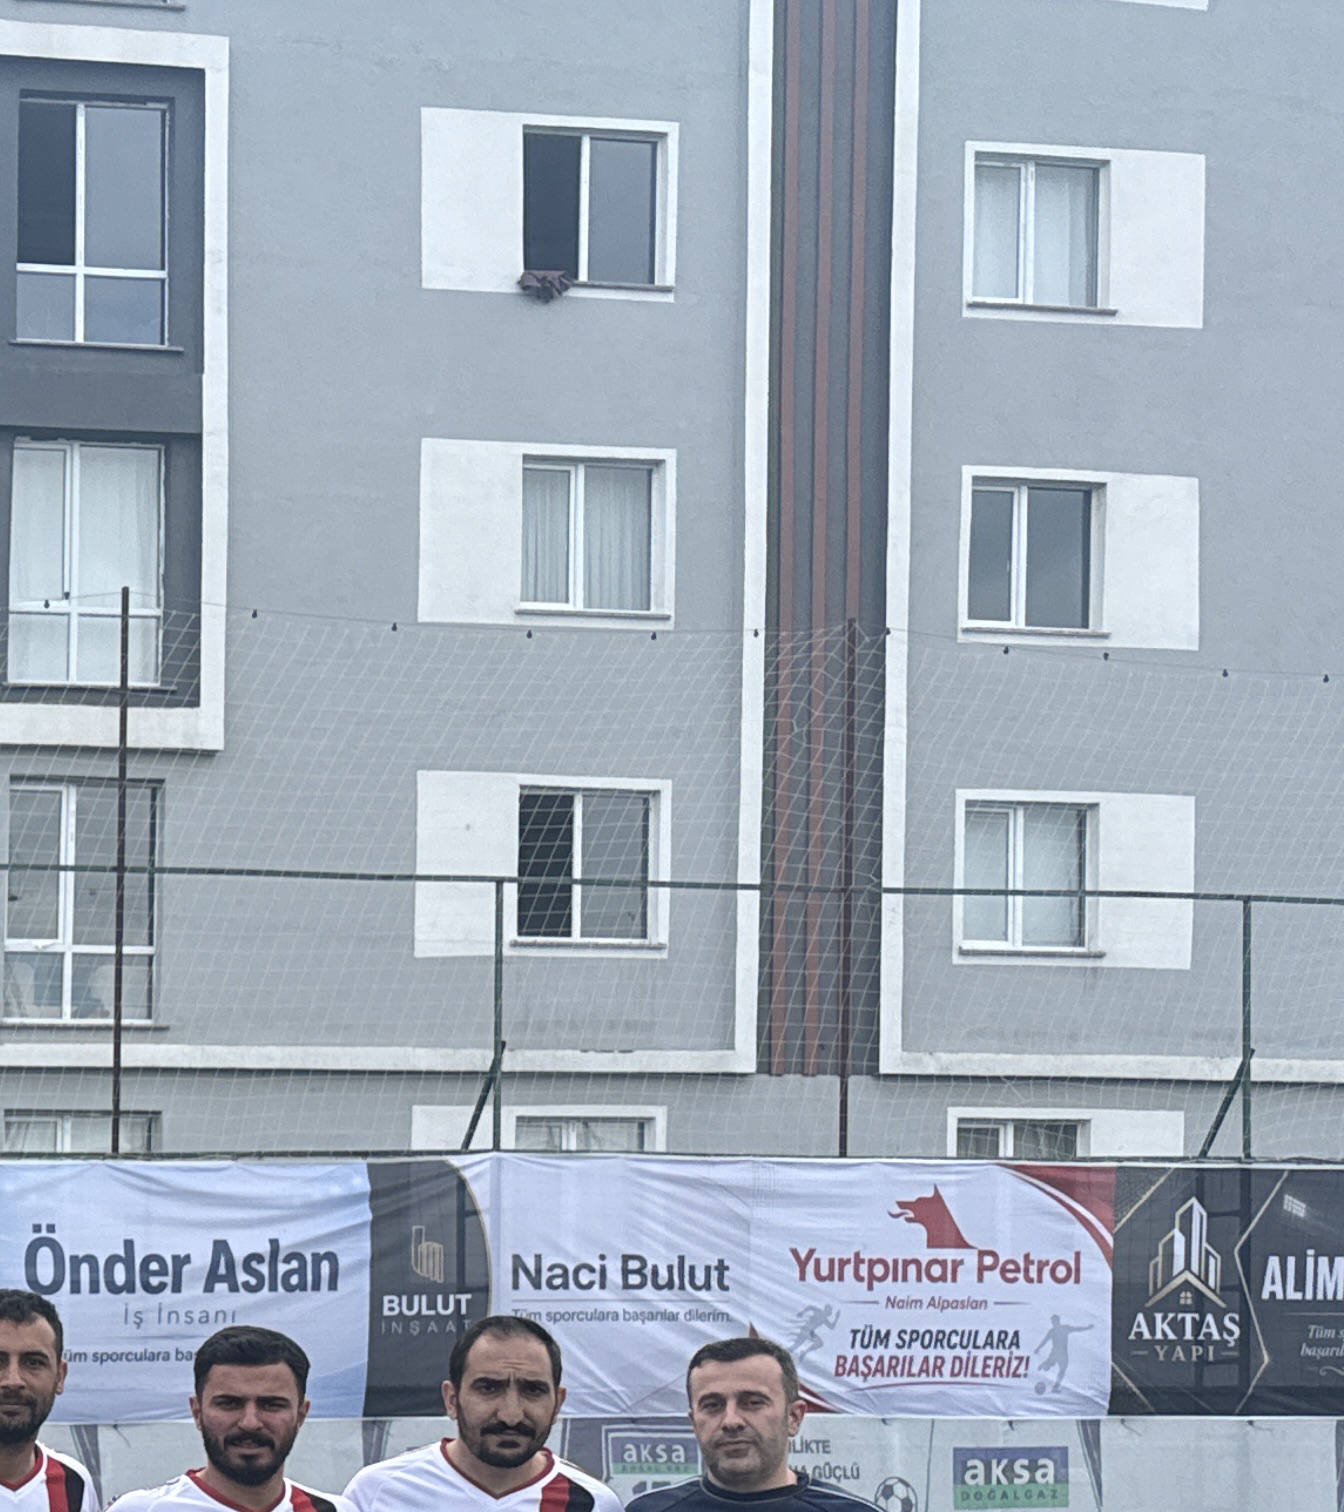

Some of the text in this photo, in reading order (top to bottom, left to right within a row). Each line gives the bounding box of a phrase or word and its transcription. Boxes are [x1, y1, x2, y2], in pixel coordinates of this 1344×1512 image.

[24, 1223, 340, 1296] Önder Aslan
[510, 1251, 731, 1293] Naci Bulut
[789, 1245, 1082, 1291] Yurtpınar Petrol
[123, 1301, 237, 1330] İş İnsanı
[382, 1292, 472, 1316] BULUT
[545, 1308, 620, 1324] sporculara
[884, 1294, 989, 1314] Naim Alpaslan
[848, 1323, 1022, 1351] TÜM SPORCULARA
[1127, 1311, 1242, 1348] AKTAŞ
[1307, 1324, 1337, 1339] Tüm
[64, 1348, 88, 1363] üm
[91, 1347, 171, 1365] sporculara
[1154, 1343, 1216, 1363] YAPI
[832, 1350, 1031, 1385] BAŞARILAR DİLERİZ!
[623, 1443, 686, 1463] aksa
[812, 1461, 860, 1483] GÜÇLÜ
[963, 1457, 1055, 1486] aksa
